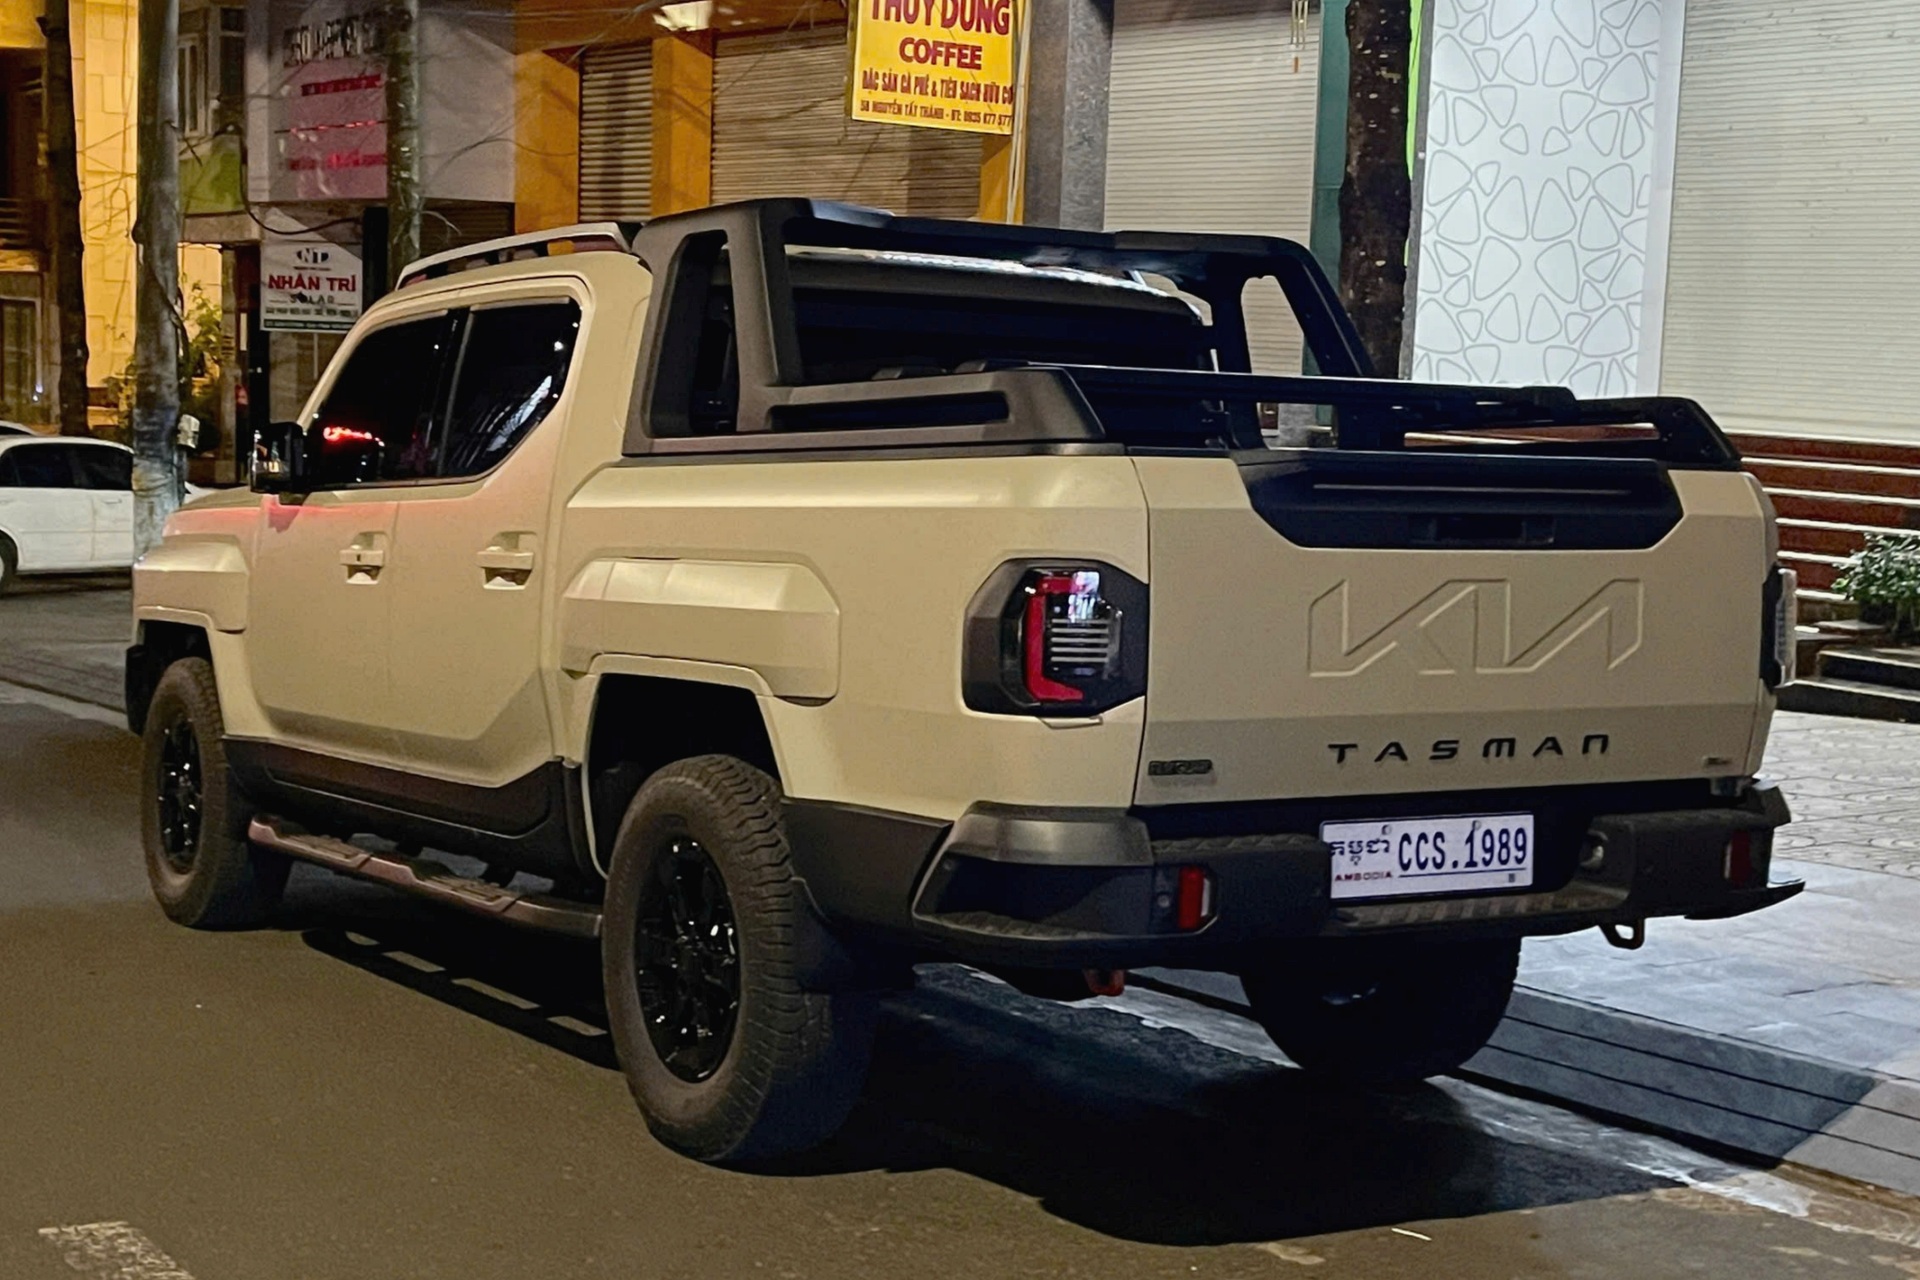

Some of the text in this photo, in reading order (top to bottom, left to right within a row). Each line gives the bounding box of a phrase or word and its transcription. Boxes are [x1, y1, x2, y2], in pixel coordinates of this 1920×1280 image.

[899, 37, 983, 70] COFFEE
[268, 273, 320, 290] NHÂN
[1327, 733, 1610, 763] TASMAN
[1398, 827, 1528, 872] CCS.1989
[1334, 871, 1393, 882] AMBODIA
